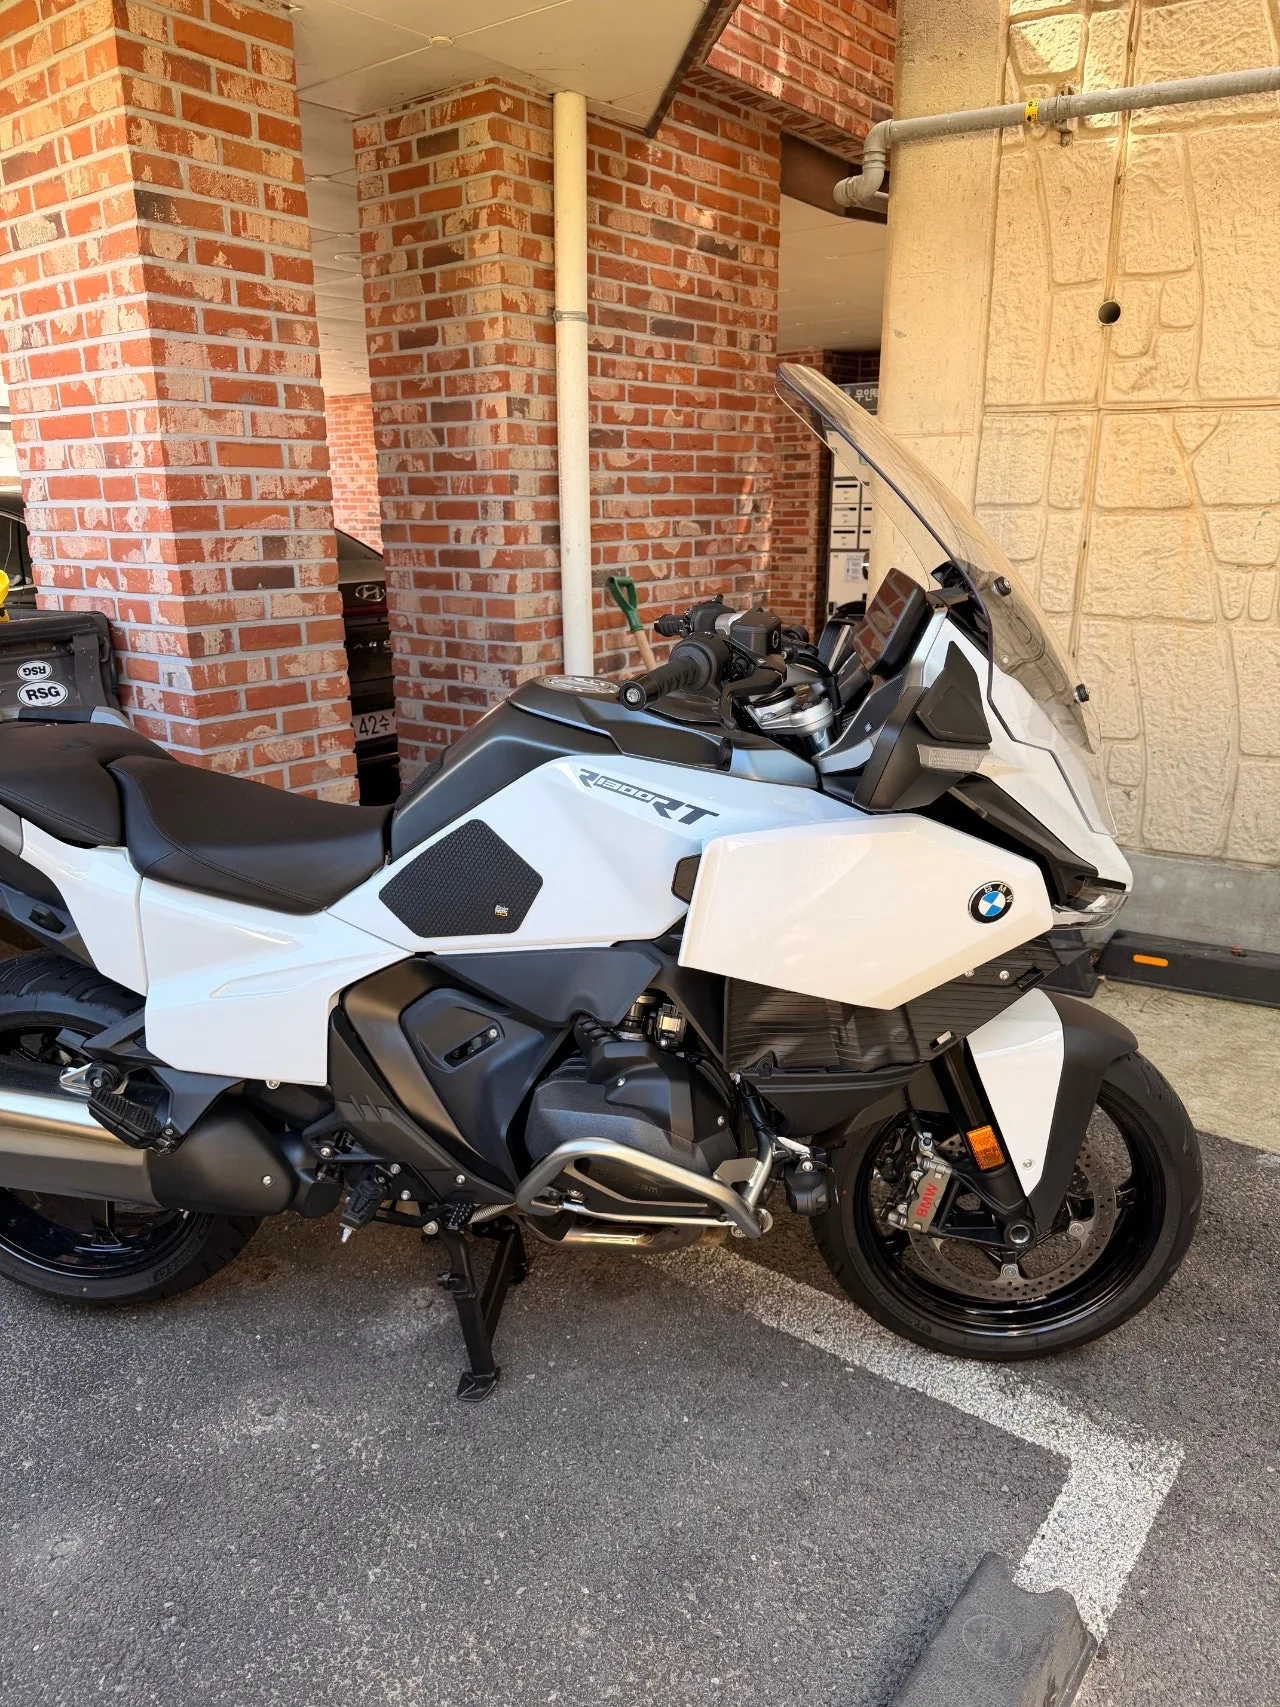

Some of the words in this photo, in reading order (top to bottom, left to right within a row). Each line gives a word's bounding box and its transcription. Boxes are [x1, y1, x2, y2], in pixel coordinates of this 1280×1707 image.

[23, 666, 47, 676] RSG
[25, 686, 61, 701] RSG
[351, 714, 390, 737] 42수
[916, 1183, 939, 1218] BMW
